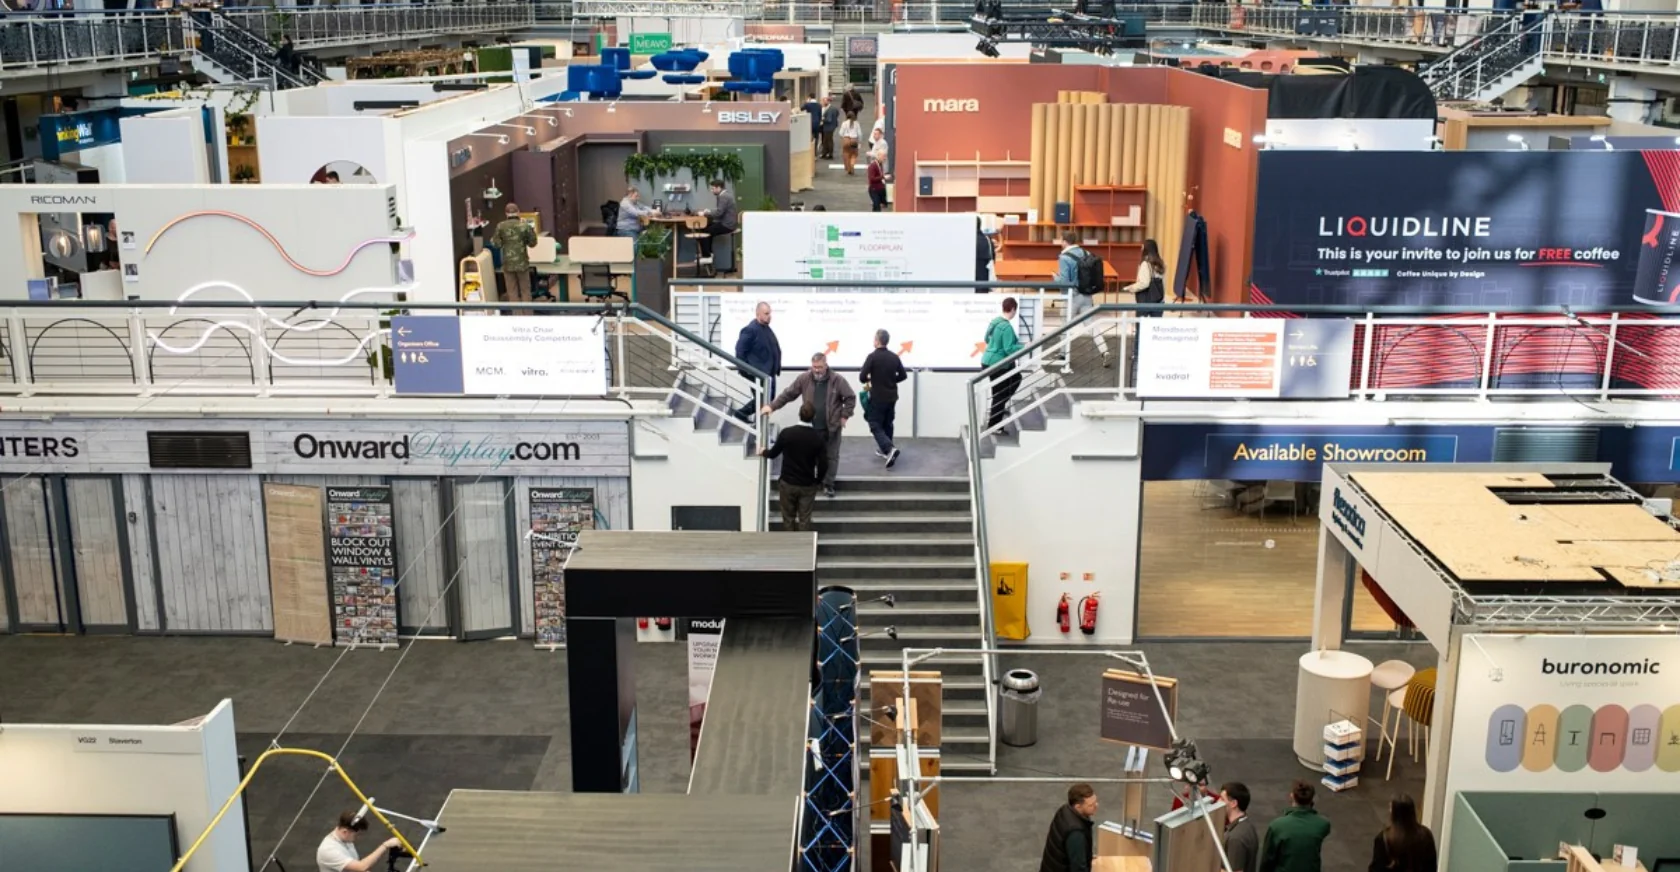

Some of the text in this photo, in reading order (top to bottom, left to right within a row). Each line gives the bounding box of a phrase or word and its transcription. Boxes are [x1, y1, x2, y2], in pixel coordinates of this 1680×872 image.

[636, 40, 667, 48] MEAVO
[924, 98, 979, 112] mara
[718, 110, 780, 123] BISLEY
[30, 196, 96, 204] RICOMAN
[1319, 216, 1491, 236] LIQUIDLINE
[1317, 247, 1620, 263] This is your invite to join us for FREE coffee
[1658, 230, 1680, 292] LIQUIDLINE
[1422, 270, 1447, 278] Unique
[1449, 270, 1458, 278] by
[1460, 270, 1484, 278] Design
[1233, 443, 1426, 462] Available Showroom
[331, 538, 391, 547] BLOCK OUT
[332, 548, 391, 556] WINDOW &
[332, 556, 392, 566] WALL VINYLS
[1542, 658, 1660, 675] buronomic
[1107, 688, 1139, 699] Designed
[1107, 696, 1130, 706] Re-use
